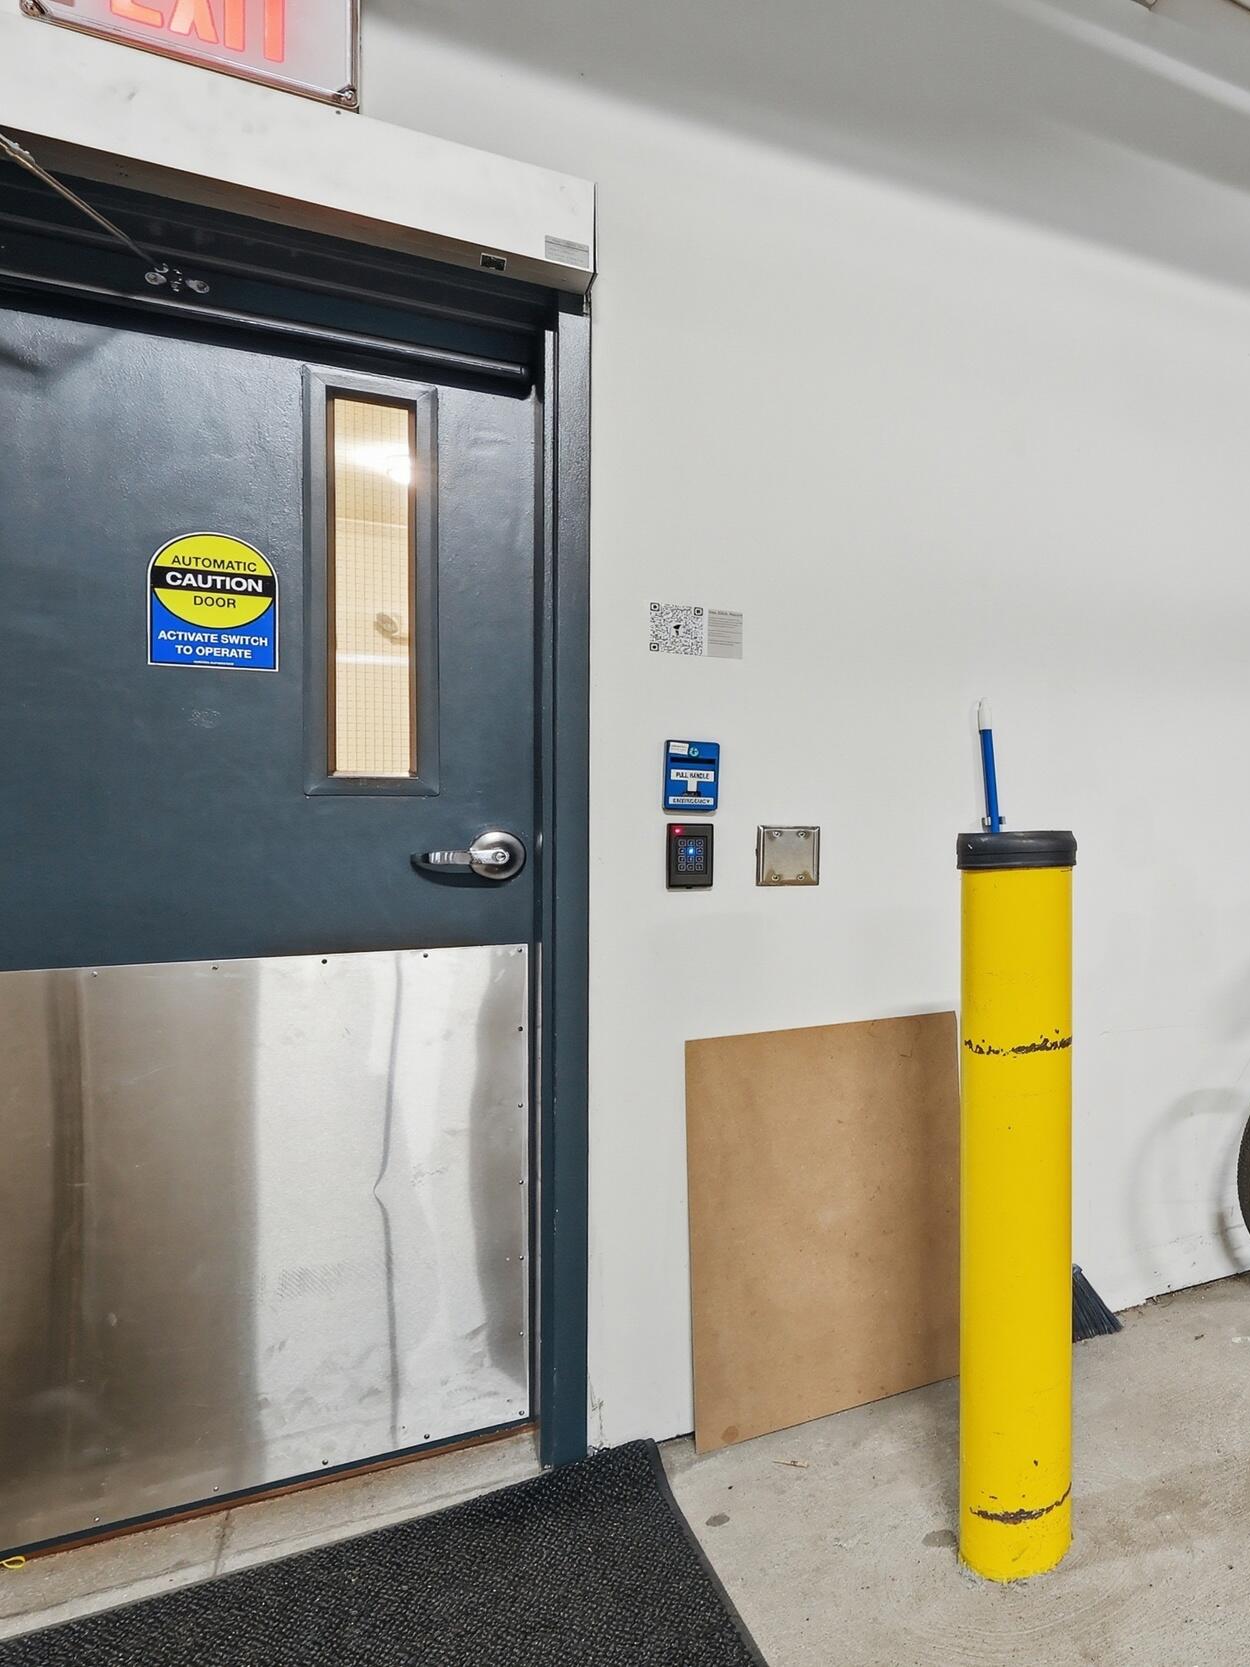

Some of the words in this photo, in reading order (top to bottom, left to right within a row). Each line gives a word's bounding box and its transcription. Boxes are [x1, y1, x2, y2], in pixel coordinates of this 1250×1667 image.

[171, 555, 257, 572] AUTOMATIC
[165, 571, 263, 593] CAUTION
[193, 595, 236, 609] DOOR
[158, 630, 219, 643] ACTIVATE
[220, 633, 268, 647] SWITCH
[175, 645, 193, 656] TO
[195, 645, 252, 659] OPERATE
